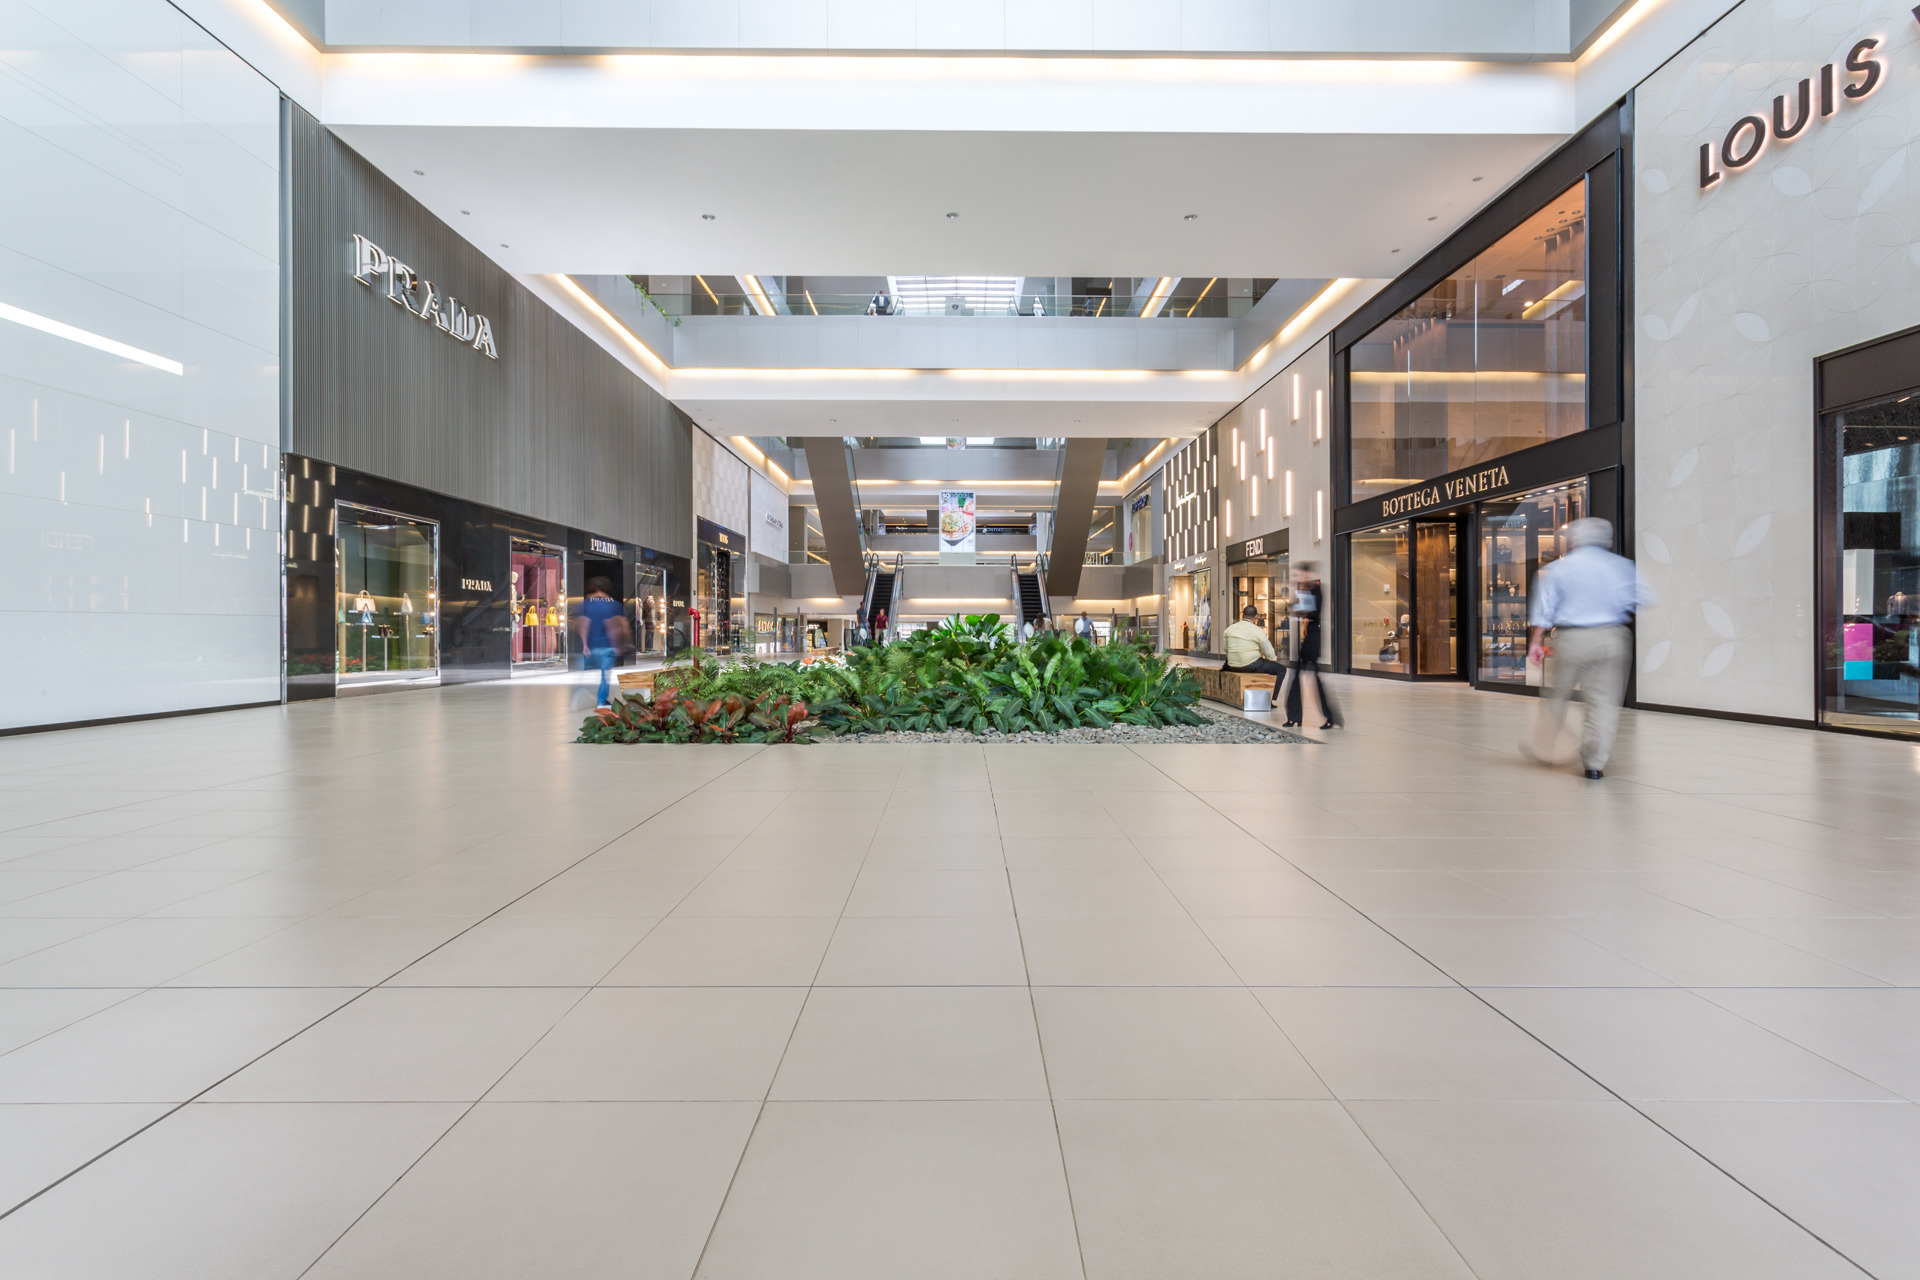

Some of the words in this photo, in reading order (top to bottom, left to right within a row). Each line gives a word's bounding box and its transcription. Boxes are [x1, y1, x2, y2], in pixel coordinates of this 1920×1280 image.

[1699, 37, 1882, 188] LOUIS
[352, 233, 499, 360] PRADA
[1382, 485, 1441, 518] BOTTEGA
[1444, 465, 1510, 500] VENETA
[590, 538, 618, 556] PRADA
[1245, 537, 1264, 558] FENDI
[461, 577, 493, 592] PRADA
